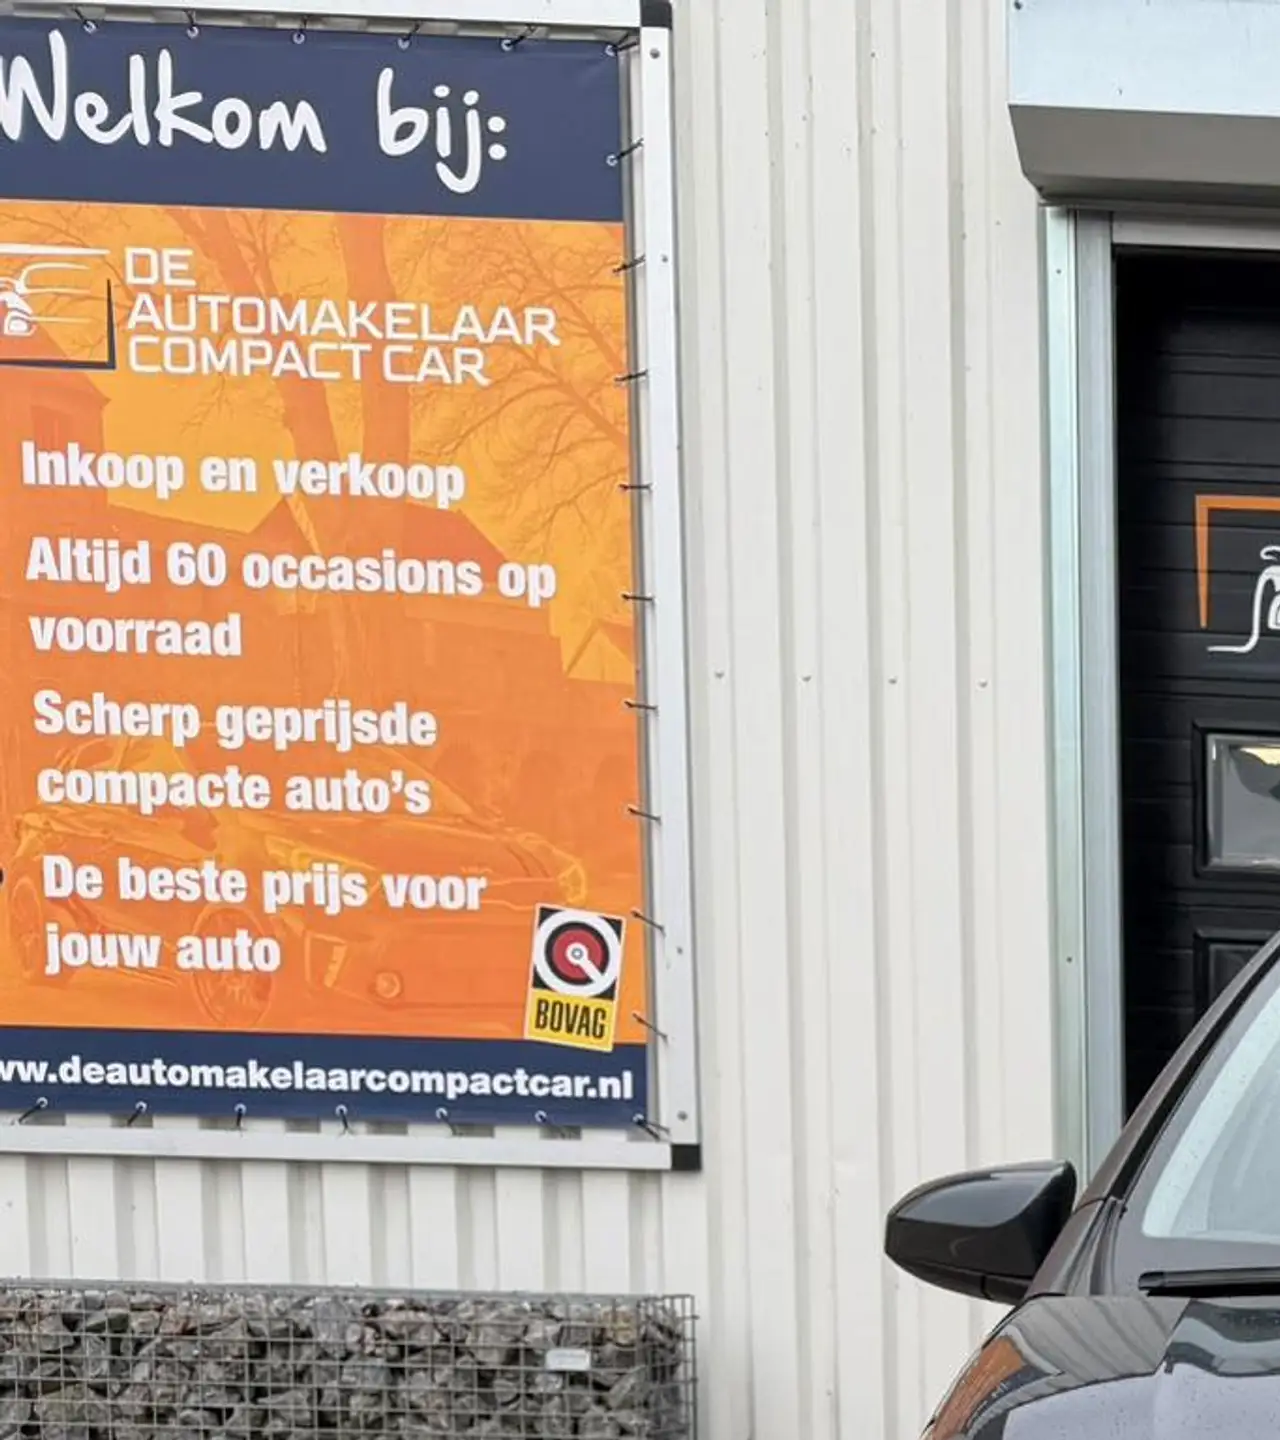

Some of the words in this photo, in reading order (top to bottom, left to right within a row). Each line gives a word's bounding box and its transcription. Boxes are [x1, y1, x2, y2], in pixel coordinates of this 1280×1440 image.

[0, 28, 327, 153] Welkom
[377, 67, 507, 193] bij:
[125, 248, 196, 287] DE
[126, 293, 561, 346] AUTOMAKELAAR
[129, 336, 371, 381] COMPACT
[382, 344, 491, 386] CAR
[21, 440, 185, 500] Inkoop
[200, 455, 257, 492] en
[273, 452, 466, 509] verkoop
[25, 536, 151, 593] Altijd
[166, 541, 228, 587] 60
[243, 549, 483, 597] occasions
[499, 562, 557, 607] op
[29, 612, 242, 658] voorraad
[33, 689, 201, 745] Scherp
[216, 698, 438, 750] geprijsde
[37, 765, 271, 815] compacte
[285, 771, 432, 815] auto's
[42, 855, 103, 900] De
[119, 857, 248, 904] beste
[263, 861, 369, 915] prijs
[381, 871, 487, 911] voor
[45, 922, 161, 975] jouw
[176, 929, 281, 973] auto
[534, 999, 606, 1041] BOVAG
